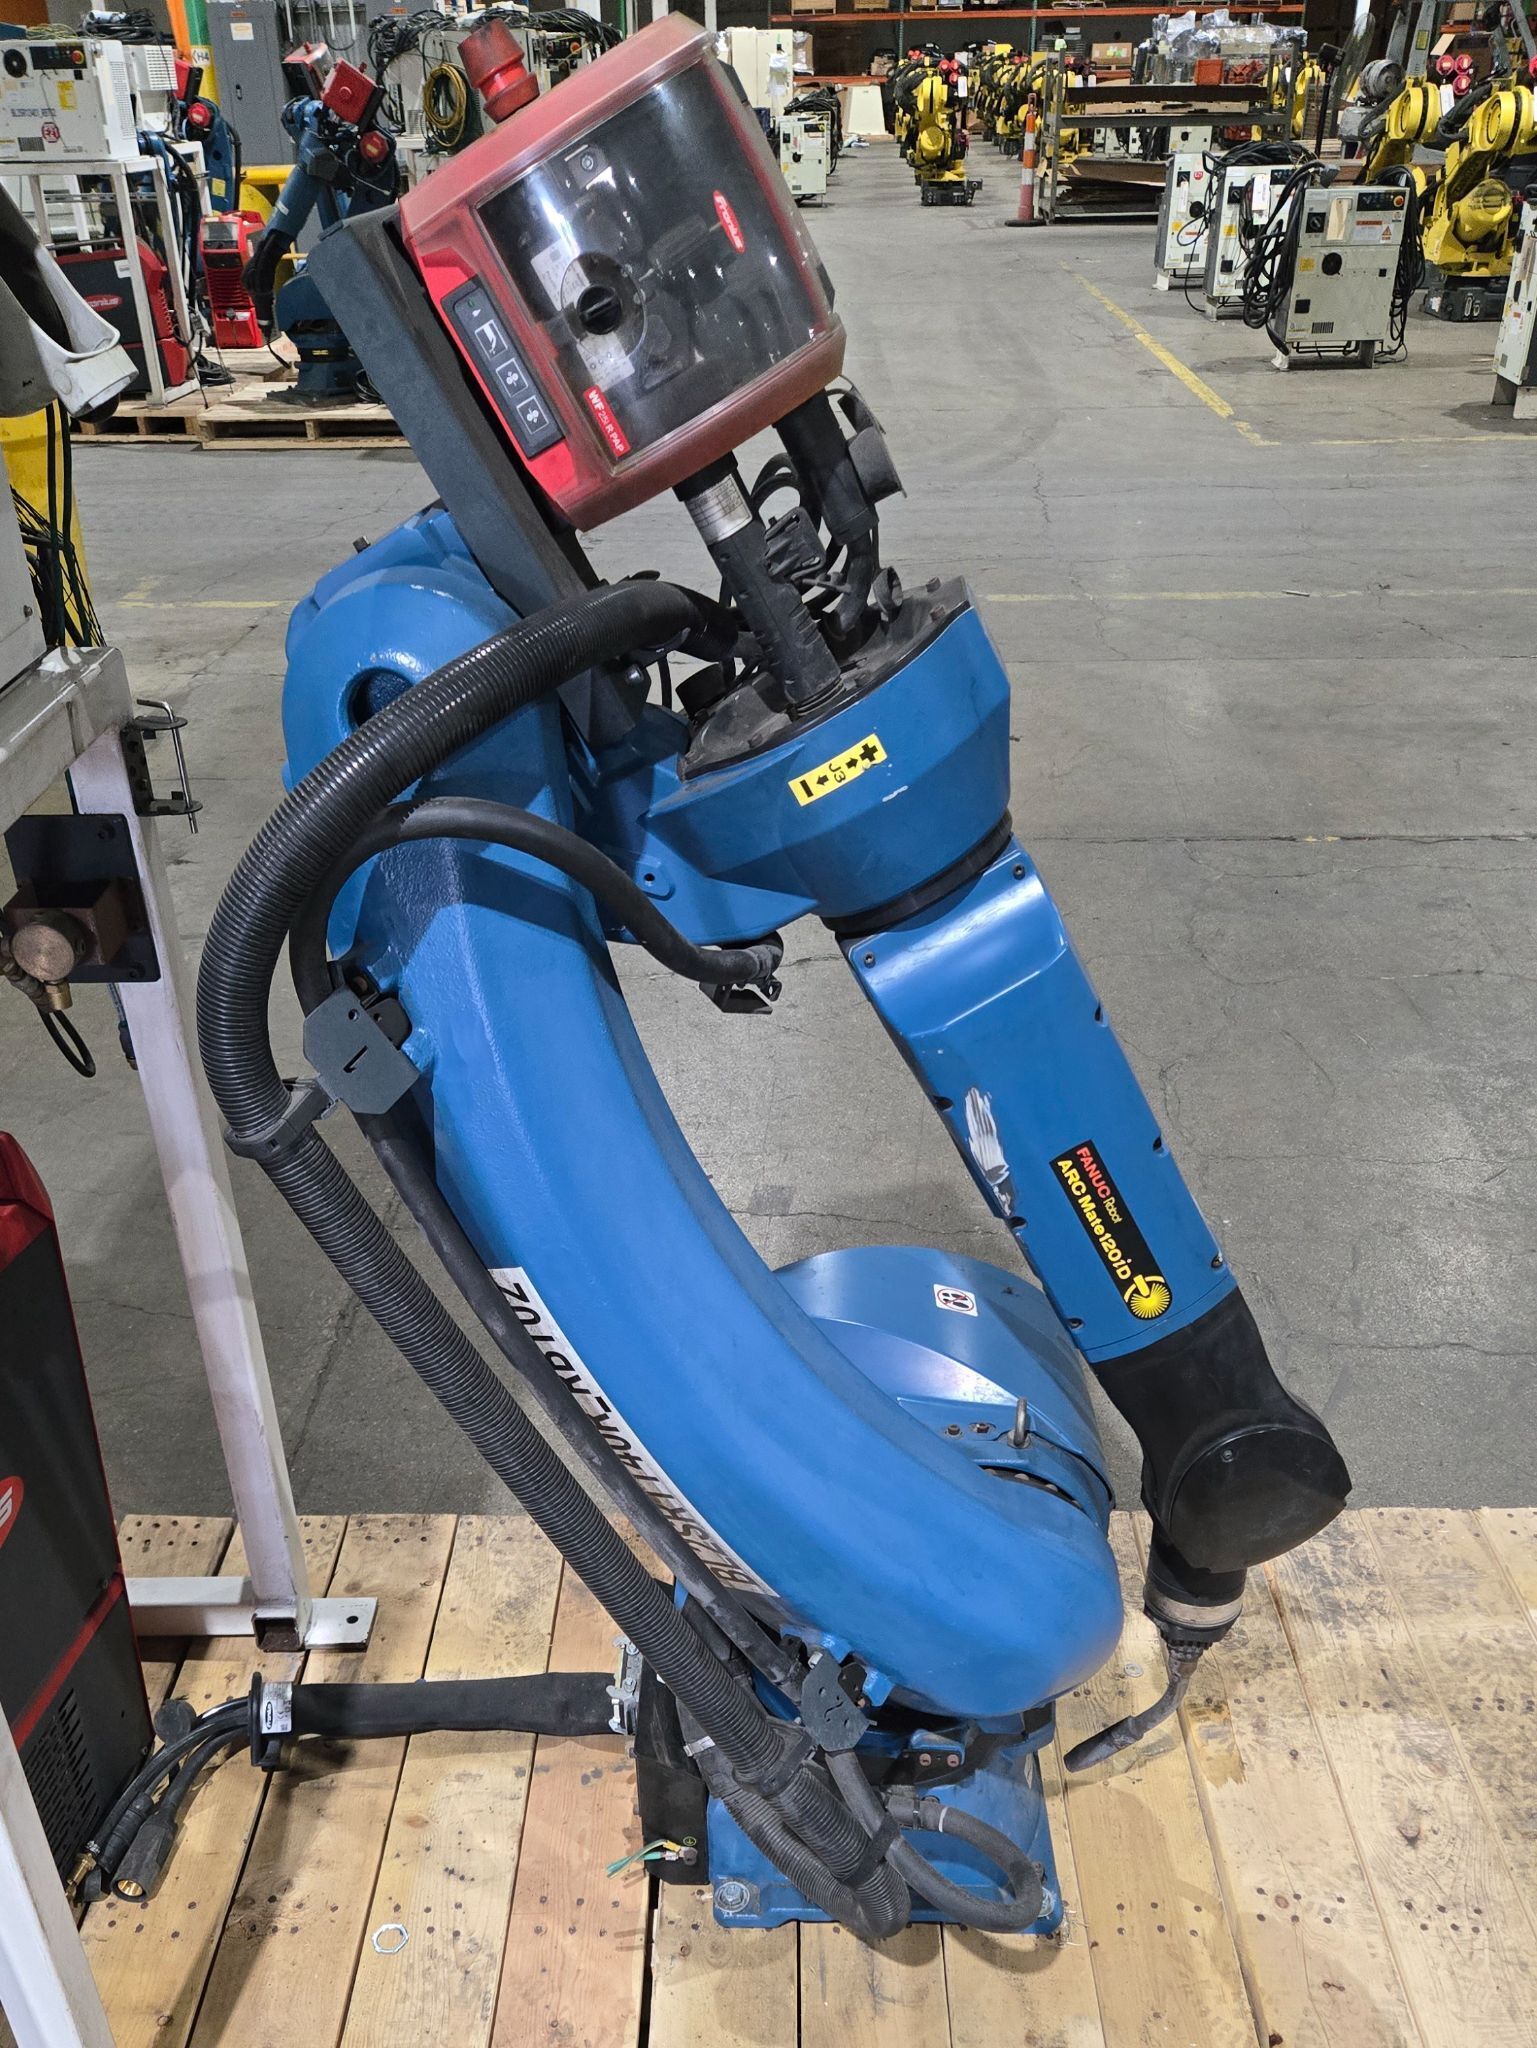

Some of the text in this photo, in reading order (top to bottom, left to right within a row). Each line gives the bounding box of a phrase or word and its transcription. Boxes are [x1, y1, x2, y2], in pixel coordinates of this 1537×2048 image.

[714, 195, 744, 248] Fronius
[588, 389, 605, 411] WF
[605, 423, 615, 434] R
[609, 433, 625, 452] PAP
[828, 763, 846, 784] J3
[1057, 1159, 1087, 1196] ARC
[1076, 1146, 1123, 1225] FANUC Robot
